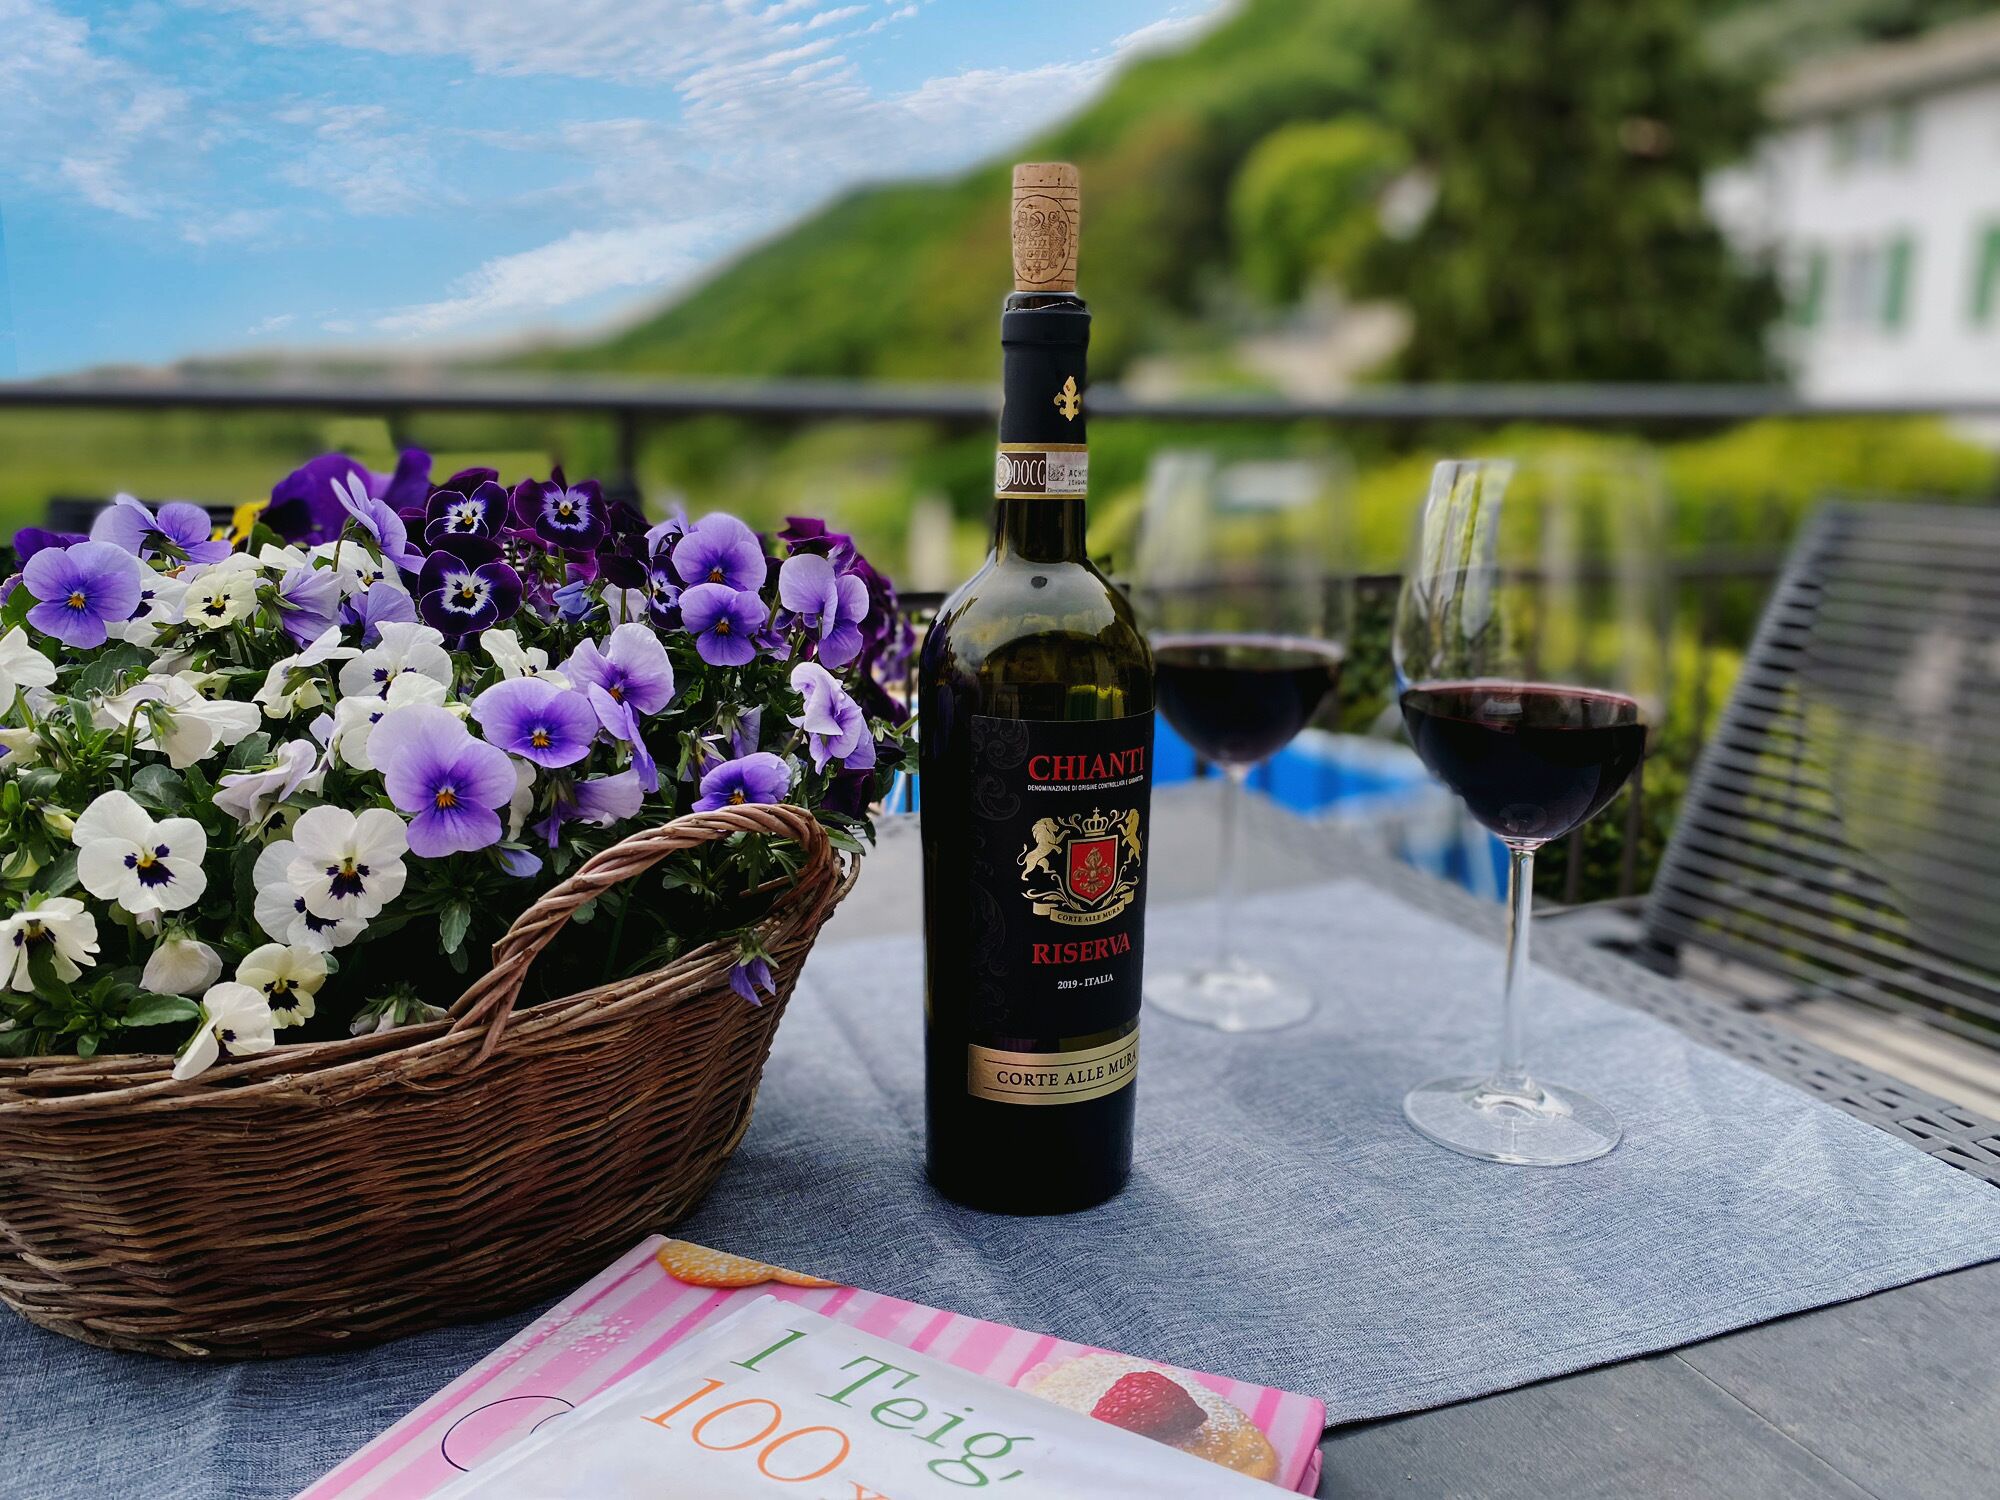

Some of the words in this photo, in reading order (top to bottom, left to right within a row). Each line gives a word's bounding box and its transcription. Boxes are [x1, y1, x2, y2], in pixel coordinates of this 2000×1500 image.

[1013, 460, 1045, 486] DOCG
[1028, 746, 1144, 781] CHIANTI
[1027, 784, 1070, 792] DENOMINAZIONE
[1078, 783, 1098, 791] ORIGINE
[1057, 913, 1082, 922] CORTE
[1084, 914, 1101, 922] ALLE
[1102, 906, 1121, 918] MURA
[1032, 932, 1131, 965] RISERVA
[1057, 980, 1078, 990] 2019
[1084, 973, 1114, 987] ITALIA
[996, 1070, 1059, 1087] CORTE
[1064, 1065, 1104, 1086] ALLE
[1108, 1049, 1137, 1076] MURA
[730, 1328, 808, 1373] 1
[816, 1355, 1035, 1488] Teig,
[640, 1377, 850, 1483] 100
